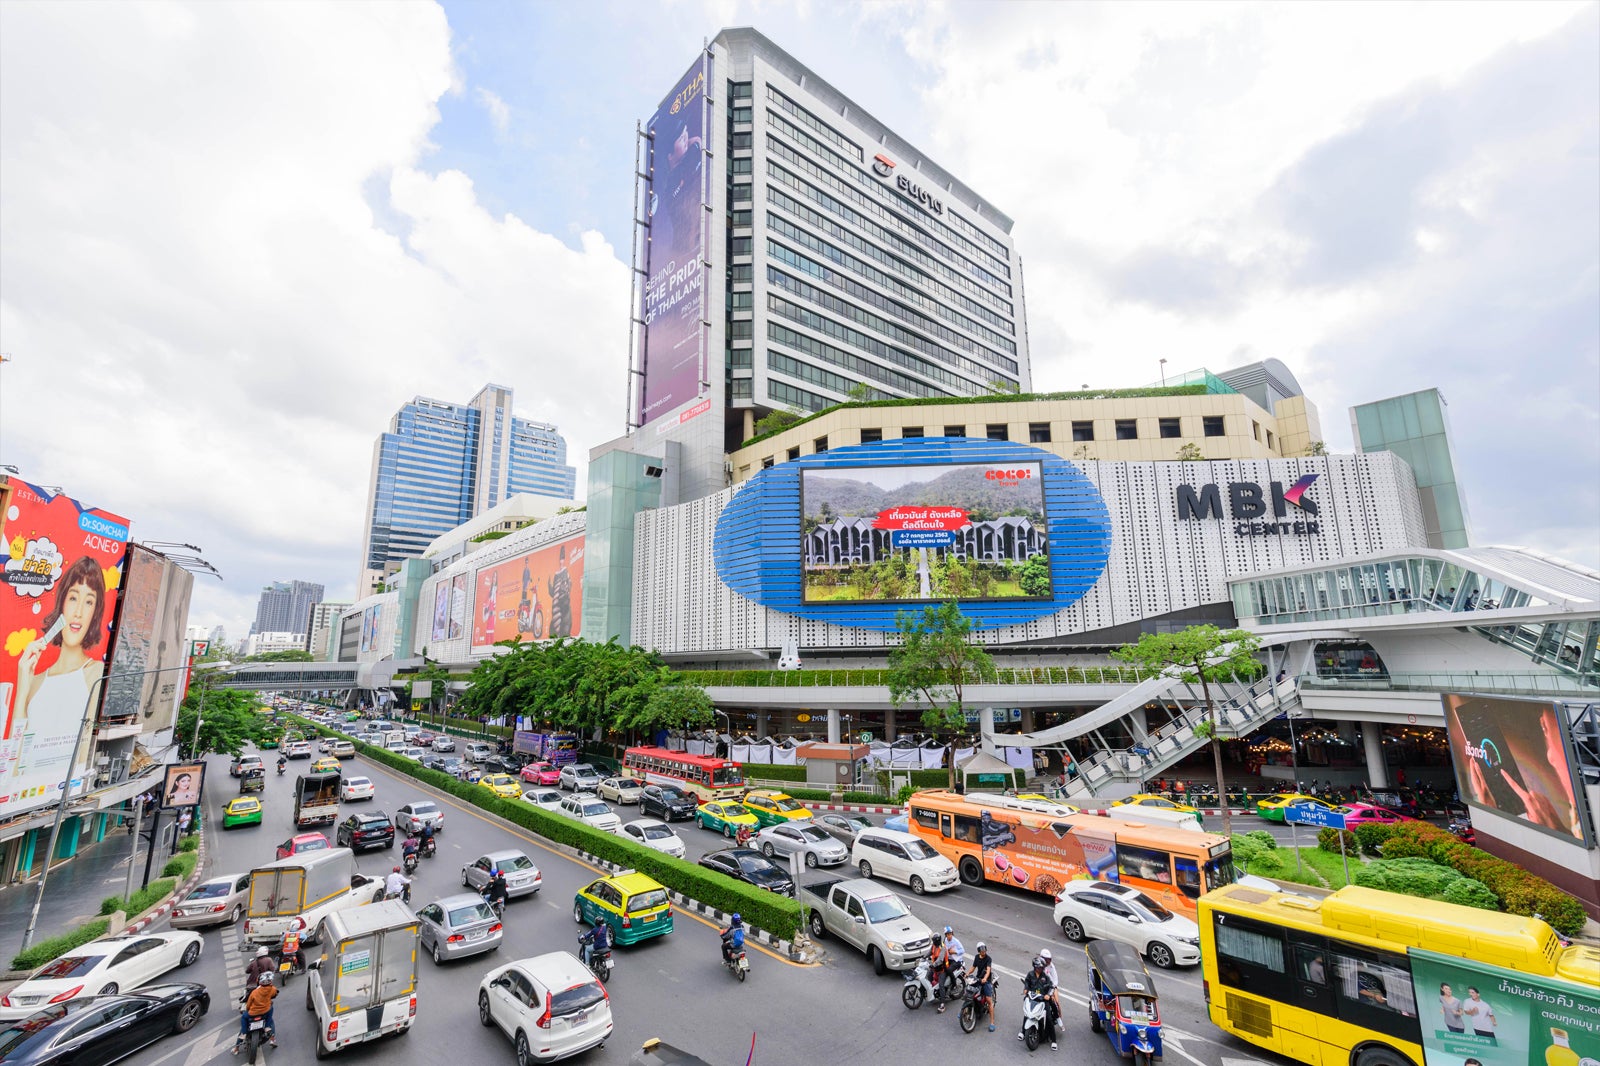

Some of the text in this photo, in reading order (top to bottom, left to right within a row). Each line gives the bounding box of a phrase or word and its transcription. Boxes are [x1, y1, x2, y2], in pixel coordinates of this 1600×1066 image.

[896, 174, 943, 215] ธนชาต
[645, 253, 702, 309] THE PRIDE
[646, 260, 675, 293] BEHIND
[645, 273, 701, 325] OF THAILAND
[1176, 474, 1320, 521] MBK
[81, 516, 124, 539] Dr.SOMCHAI
[902, 519, 945, 529] ดีลดีโดนใจ
[1236, 521, 1320, 535] CENTER
[13, 543, 23, 553] No.
[83, 533, 111, 553] ACNE
[1300, 811, 1327, 821] ปทุมวัน
[1022, 841, 1067, 857] #สนุกยกบ้าน
[1218, 914, 1225, 925] 7
[1541, 1010, 1593, 1031] ตอบทุกเมนู
